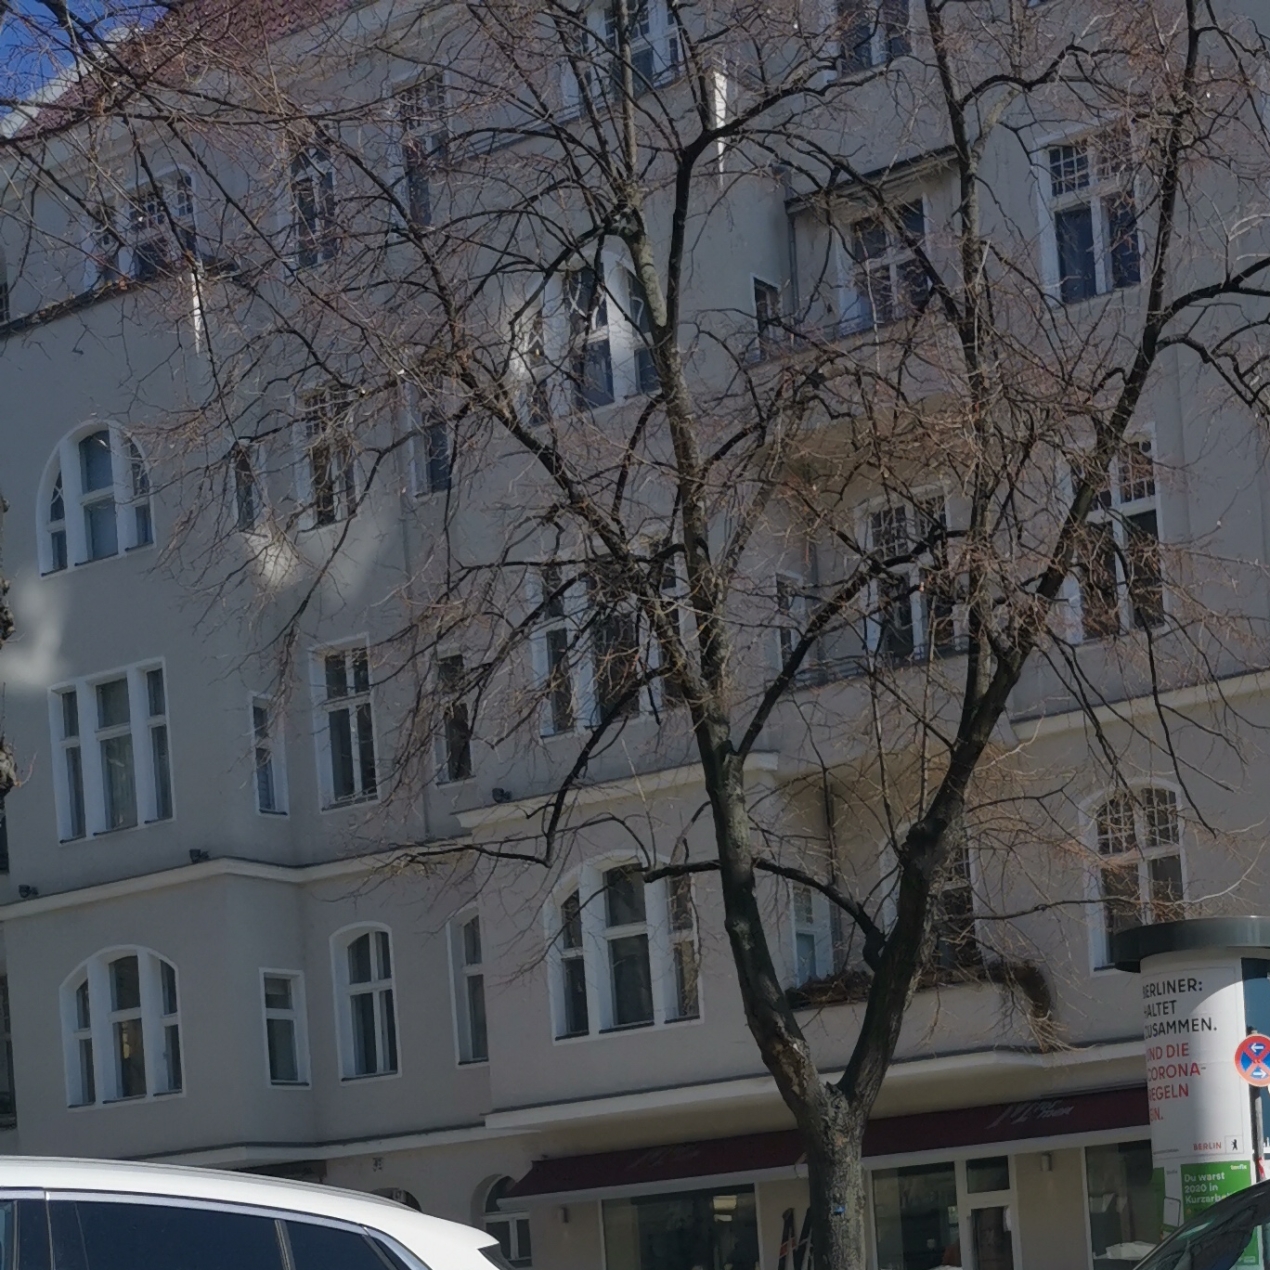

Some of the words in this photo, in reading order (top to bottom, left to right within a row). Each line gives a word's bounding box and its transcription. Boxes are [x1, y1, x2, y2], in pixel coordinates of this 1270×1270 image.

[1166, 1042, 1190, 1059] DIE
[1193, 1141, 1222, 1151] BERLIN
[1184, 1173, 1196, 1183] Du
[1198, 1171, 1225, 1181] warst
[1184, 1183, 1207, 1194] 2020
[1209, 1182, 1219, 1192] in
